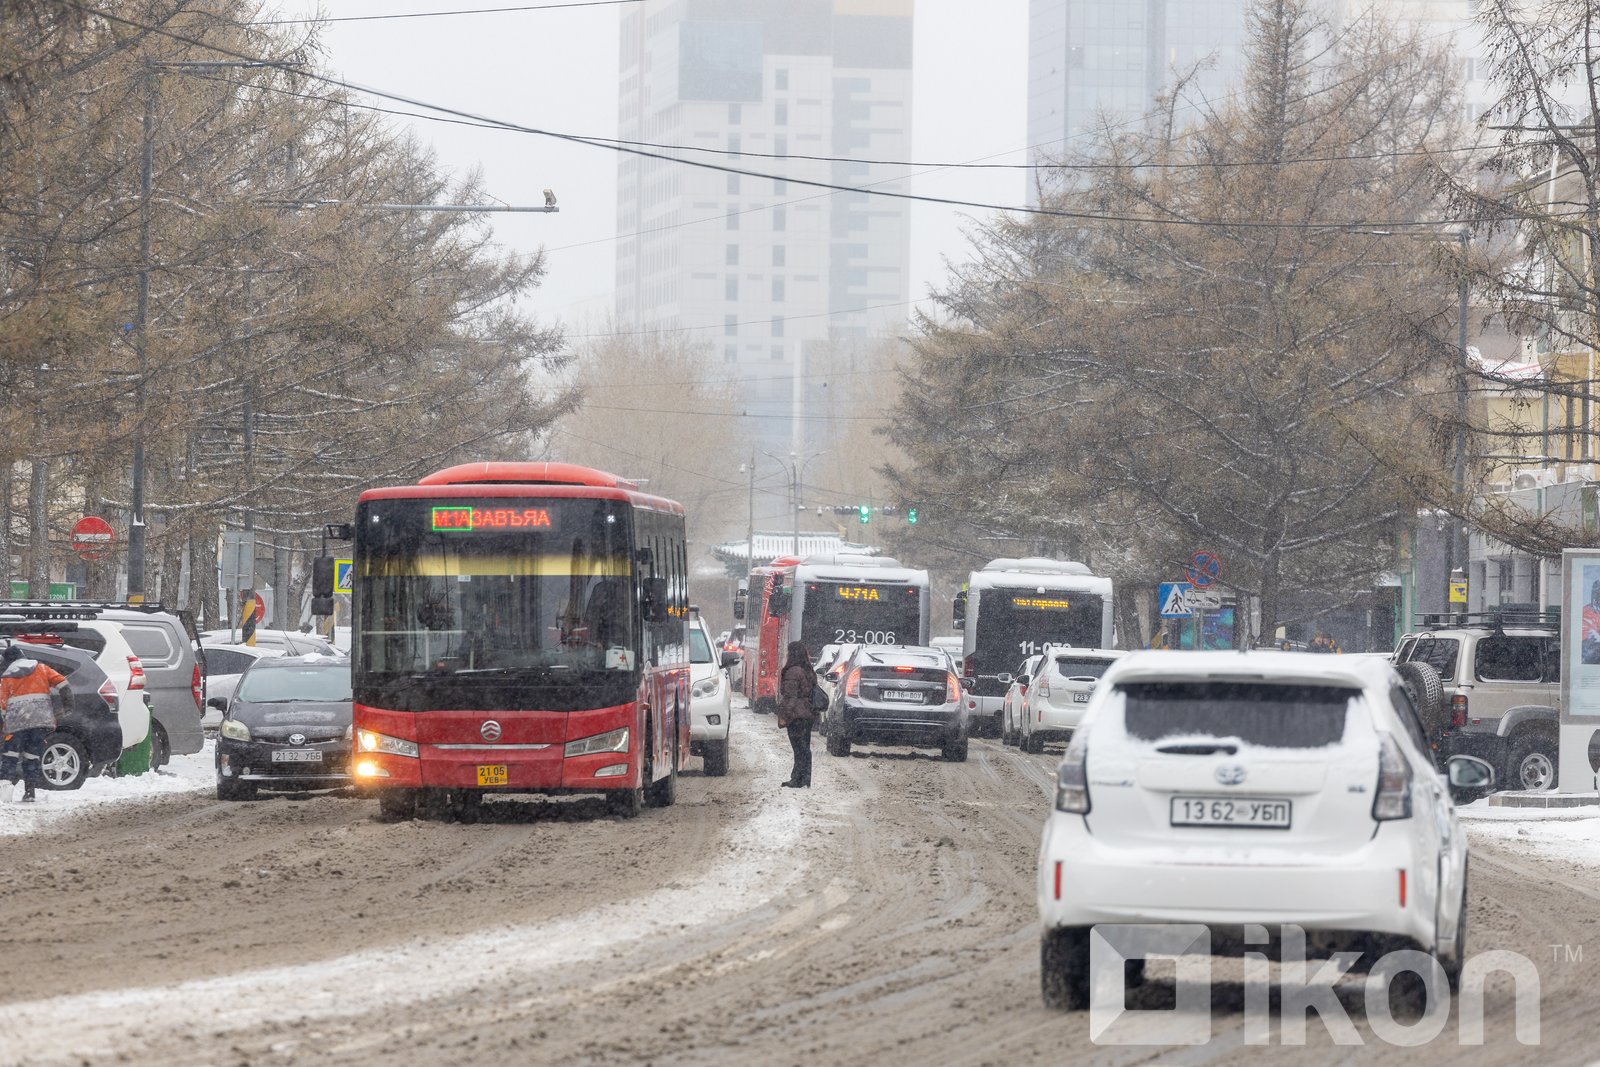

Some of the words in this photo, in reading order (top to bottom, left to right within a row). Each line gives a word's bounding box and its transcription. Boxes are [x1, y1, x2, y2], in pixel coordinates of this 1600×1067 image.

[839, 587, 879, 600] Ч-71А
[834, 629, 896, 645] 23-006
[1249, 803, 1286, 822] УБП
